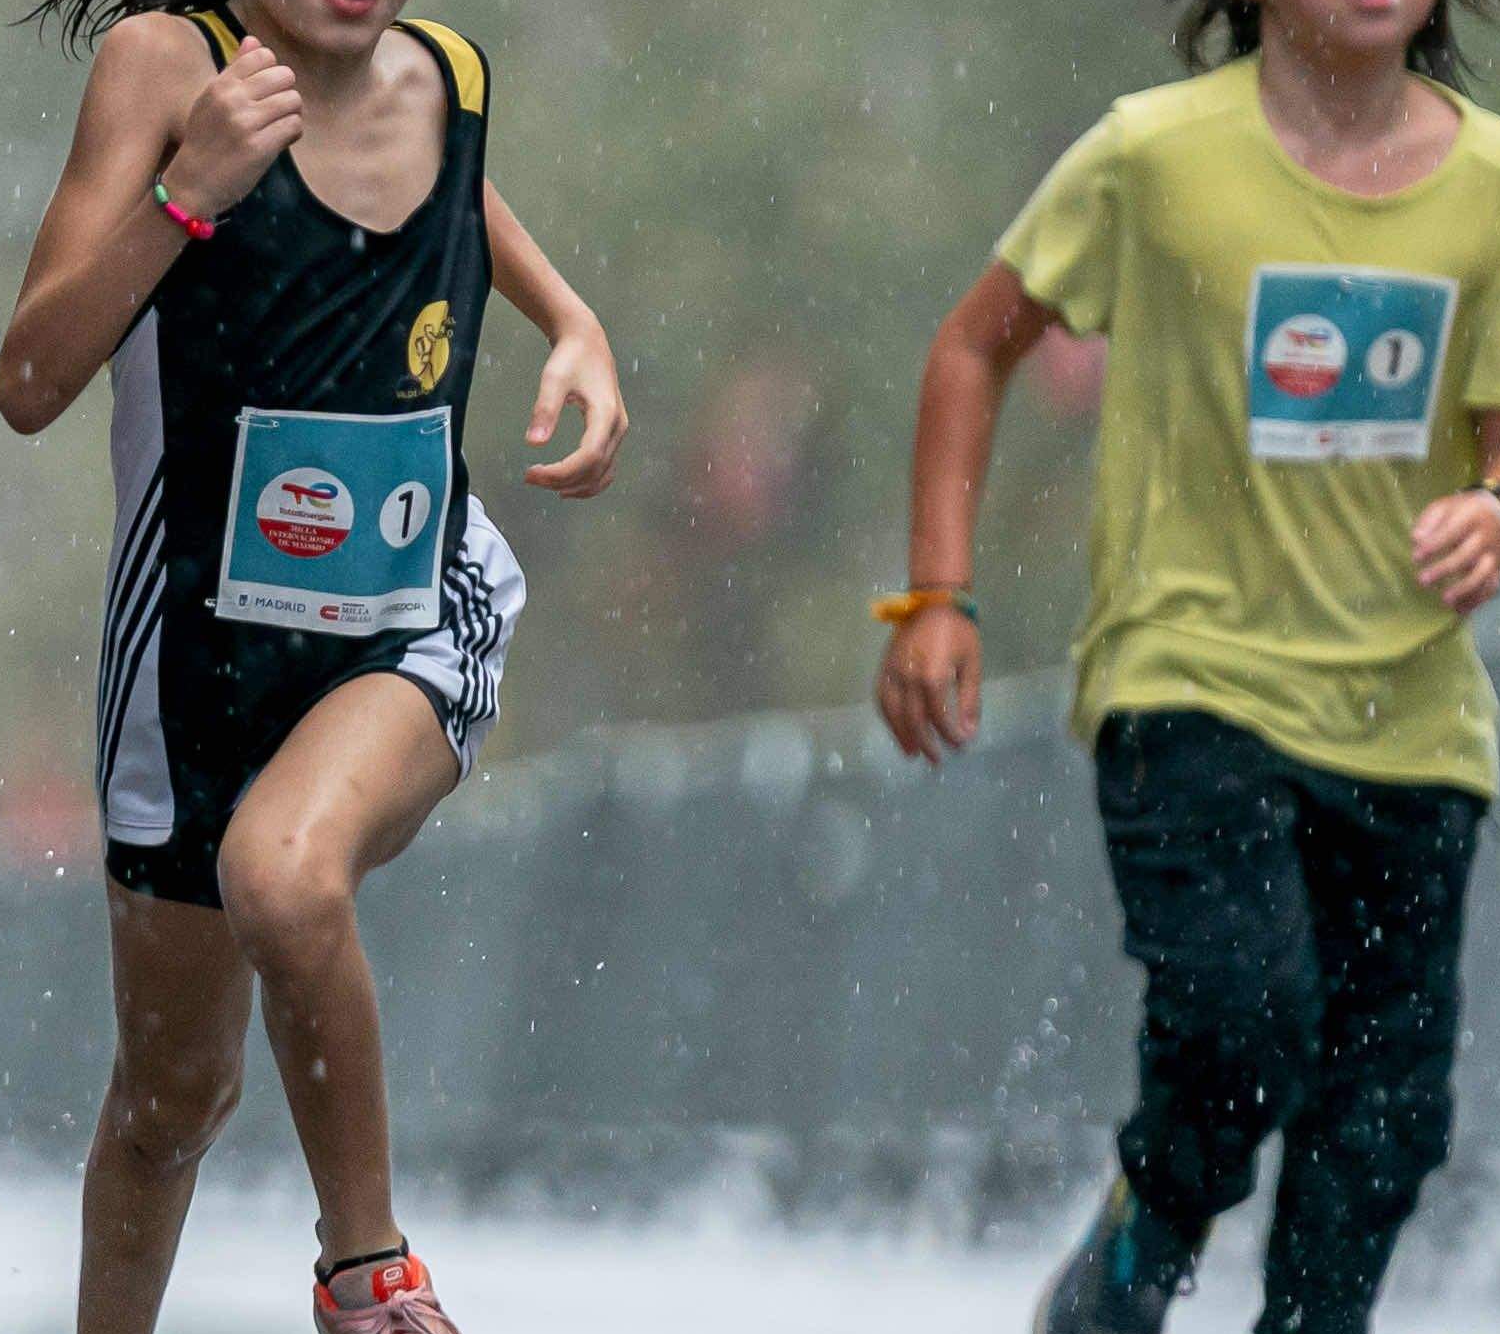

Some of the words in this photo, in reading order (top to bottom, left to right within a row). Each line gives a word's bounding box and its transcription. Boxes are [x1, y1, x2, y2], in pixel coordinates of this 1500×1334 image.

[1387, 338, 1402, 375] 1
[398, 490, 414, 539] 1
[255, 597, 306, 613] MADRID
